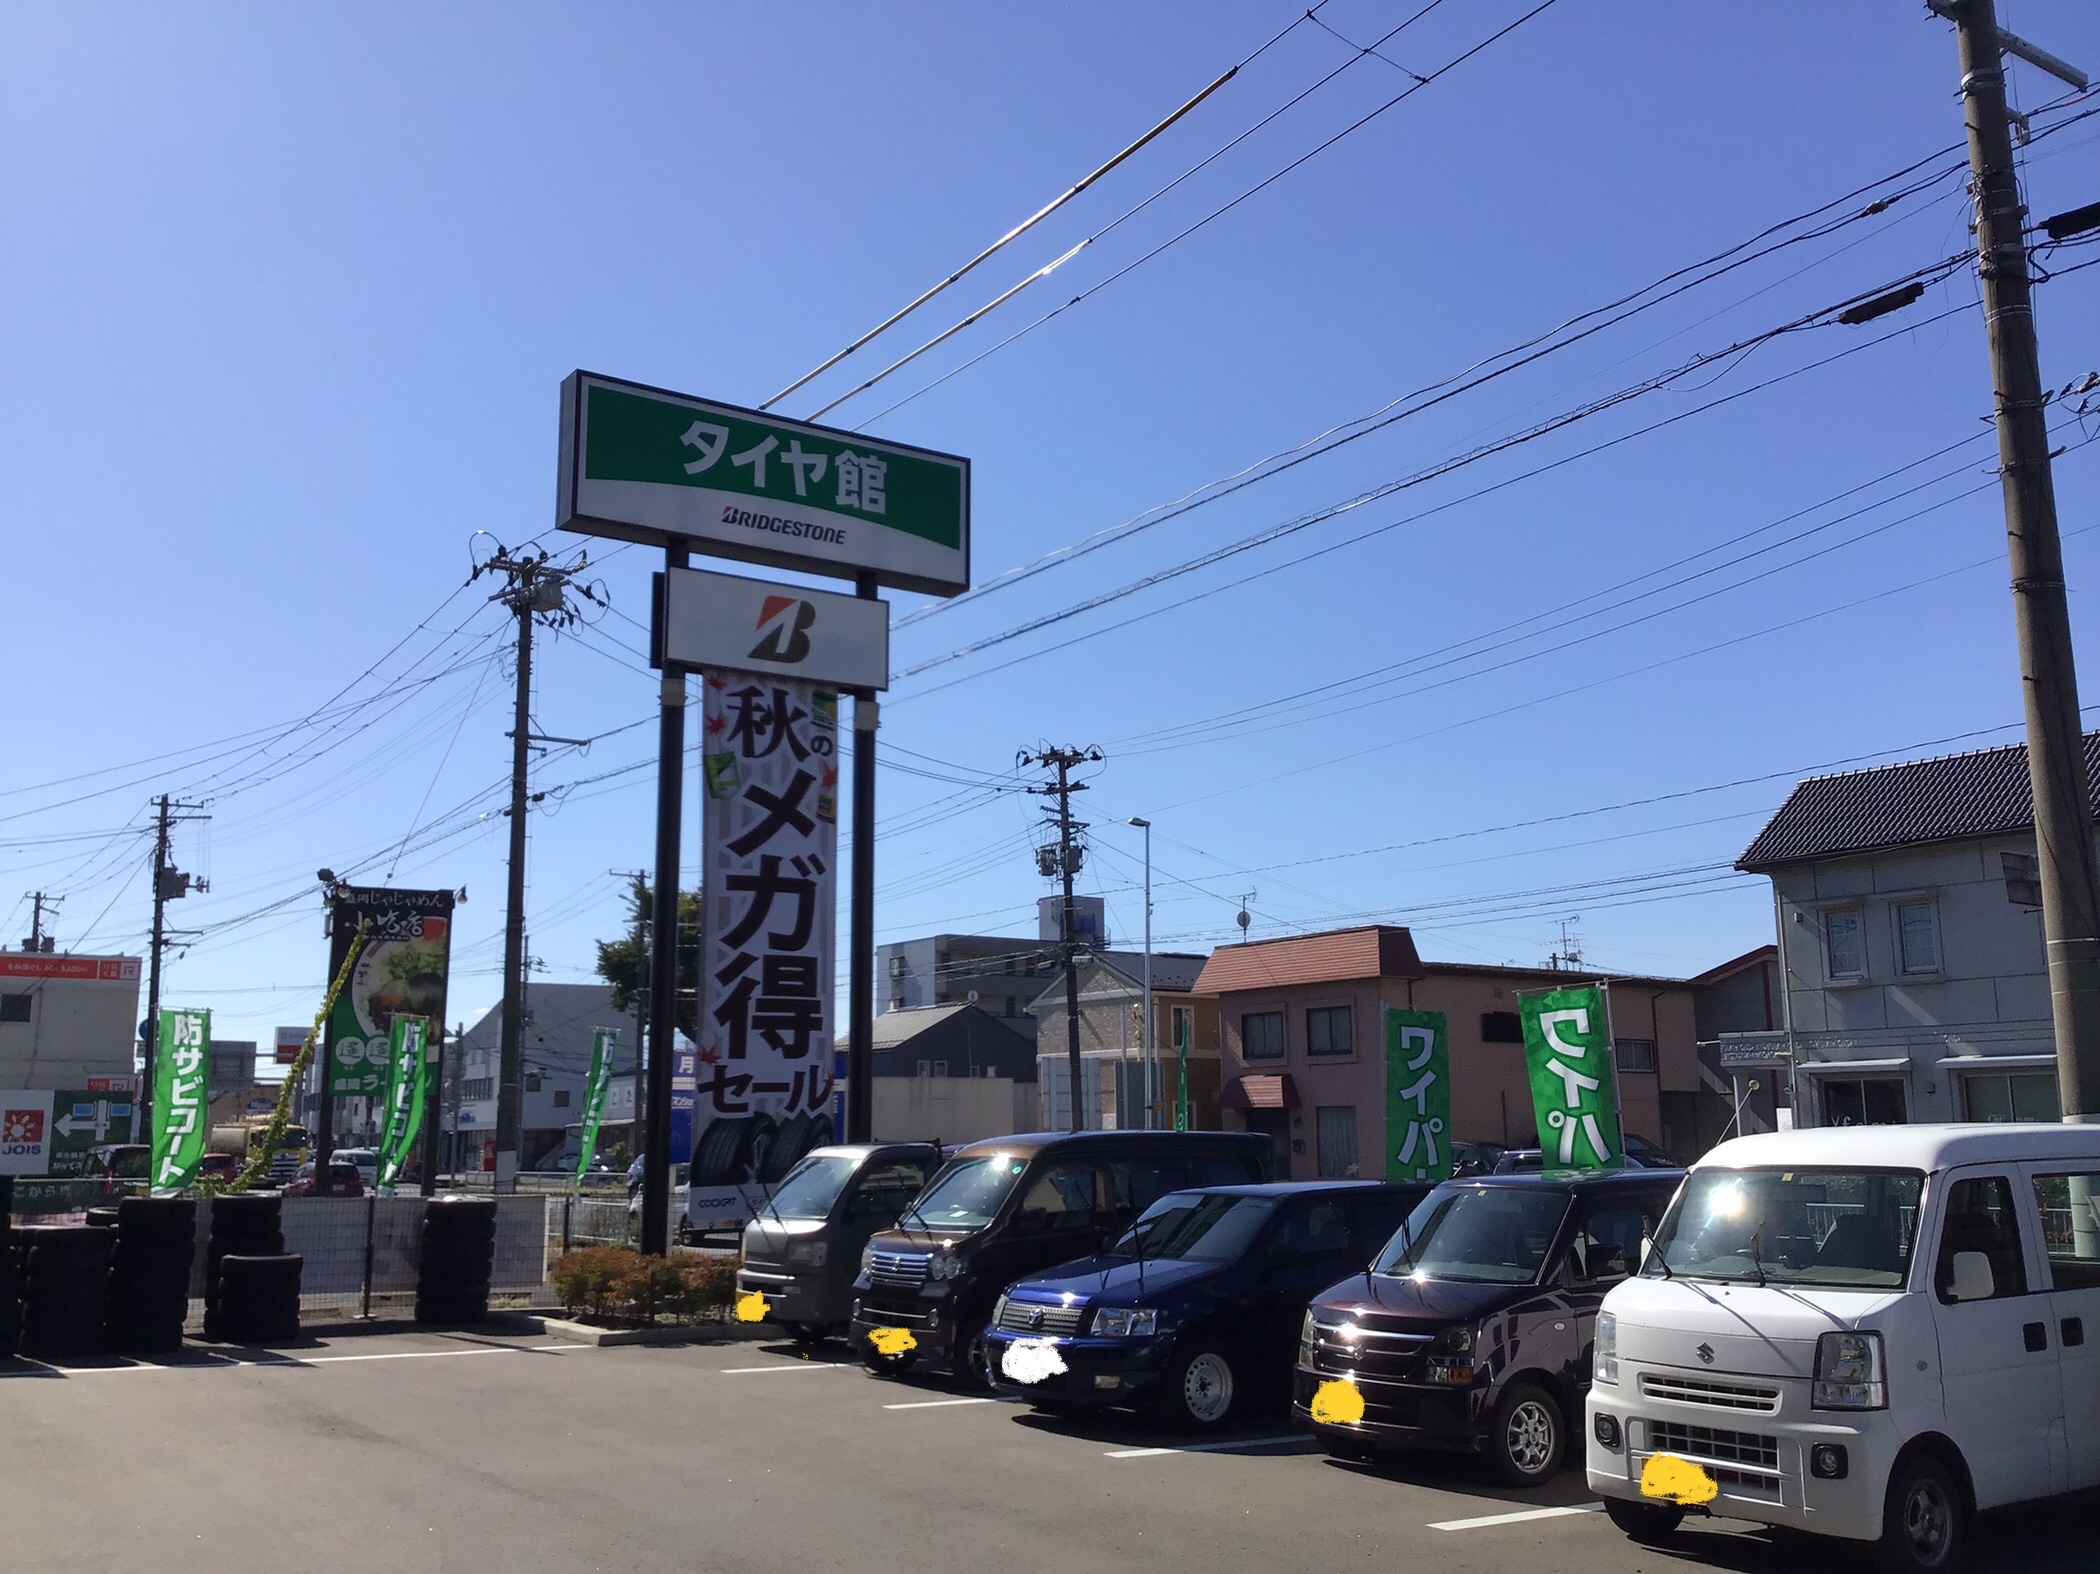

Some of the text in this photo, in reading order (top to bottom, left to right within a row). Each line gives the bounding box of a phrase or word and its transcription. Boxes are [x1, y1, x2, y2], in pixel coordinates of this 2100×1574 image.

[679, 420, 889, 515] タイヤ館
[721, 506, 846, 545] BRIDGESTONE
[158, 1014, 204, 1184] 防サビコート
[698, 1064, 834, 1114] セール
[3, 1145, 42, 1155] JOIS
